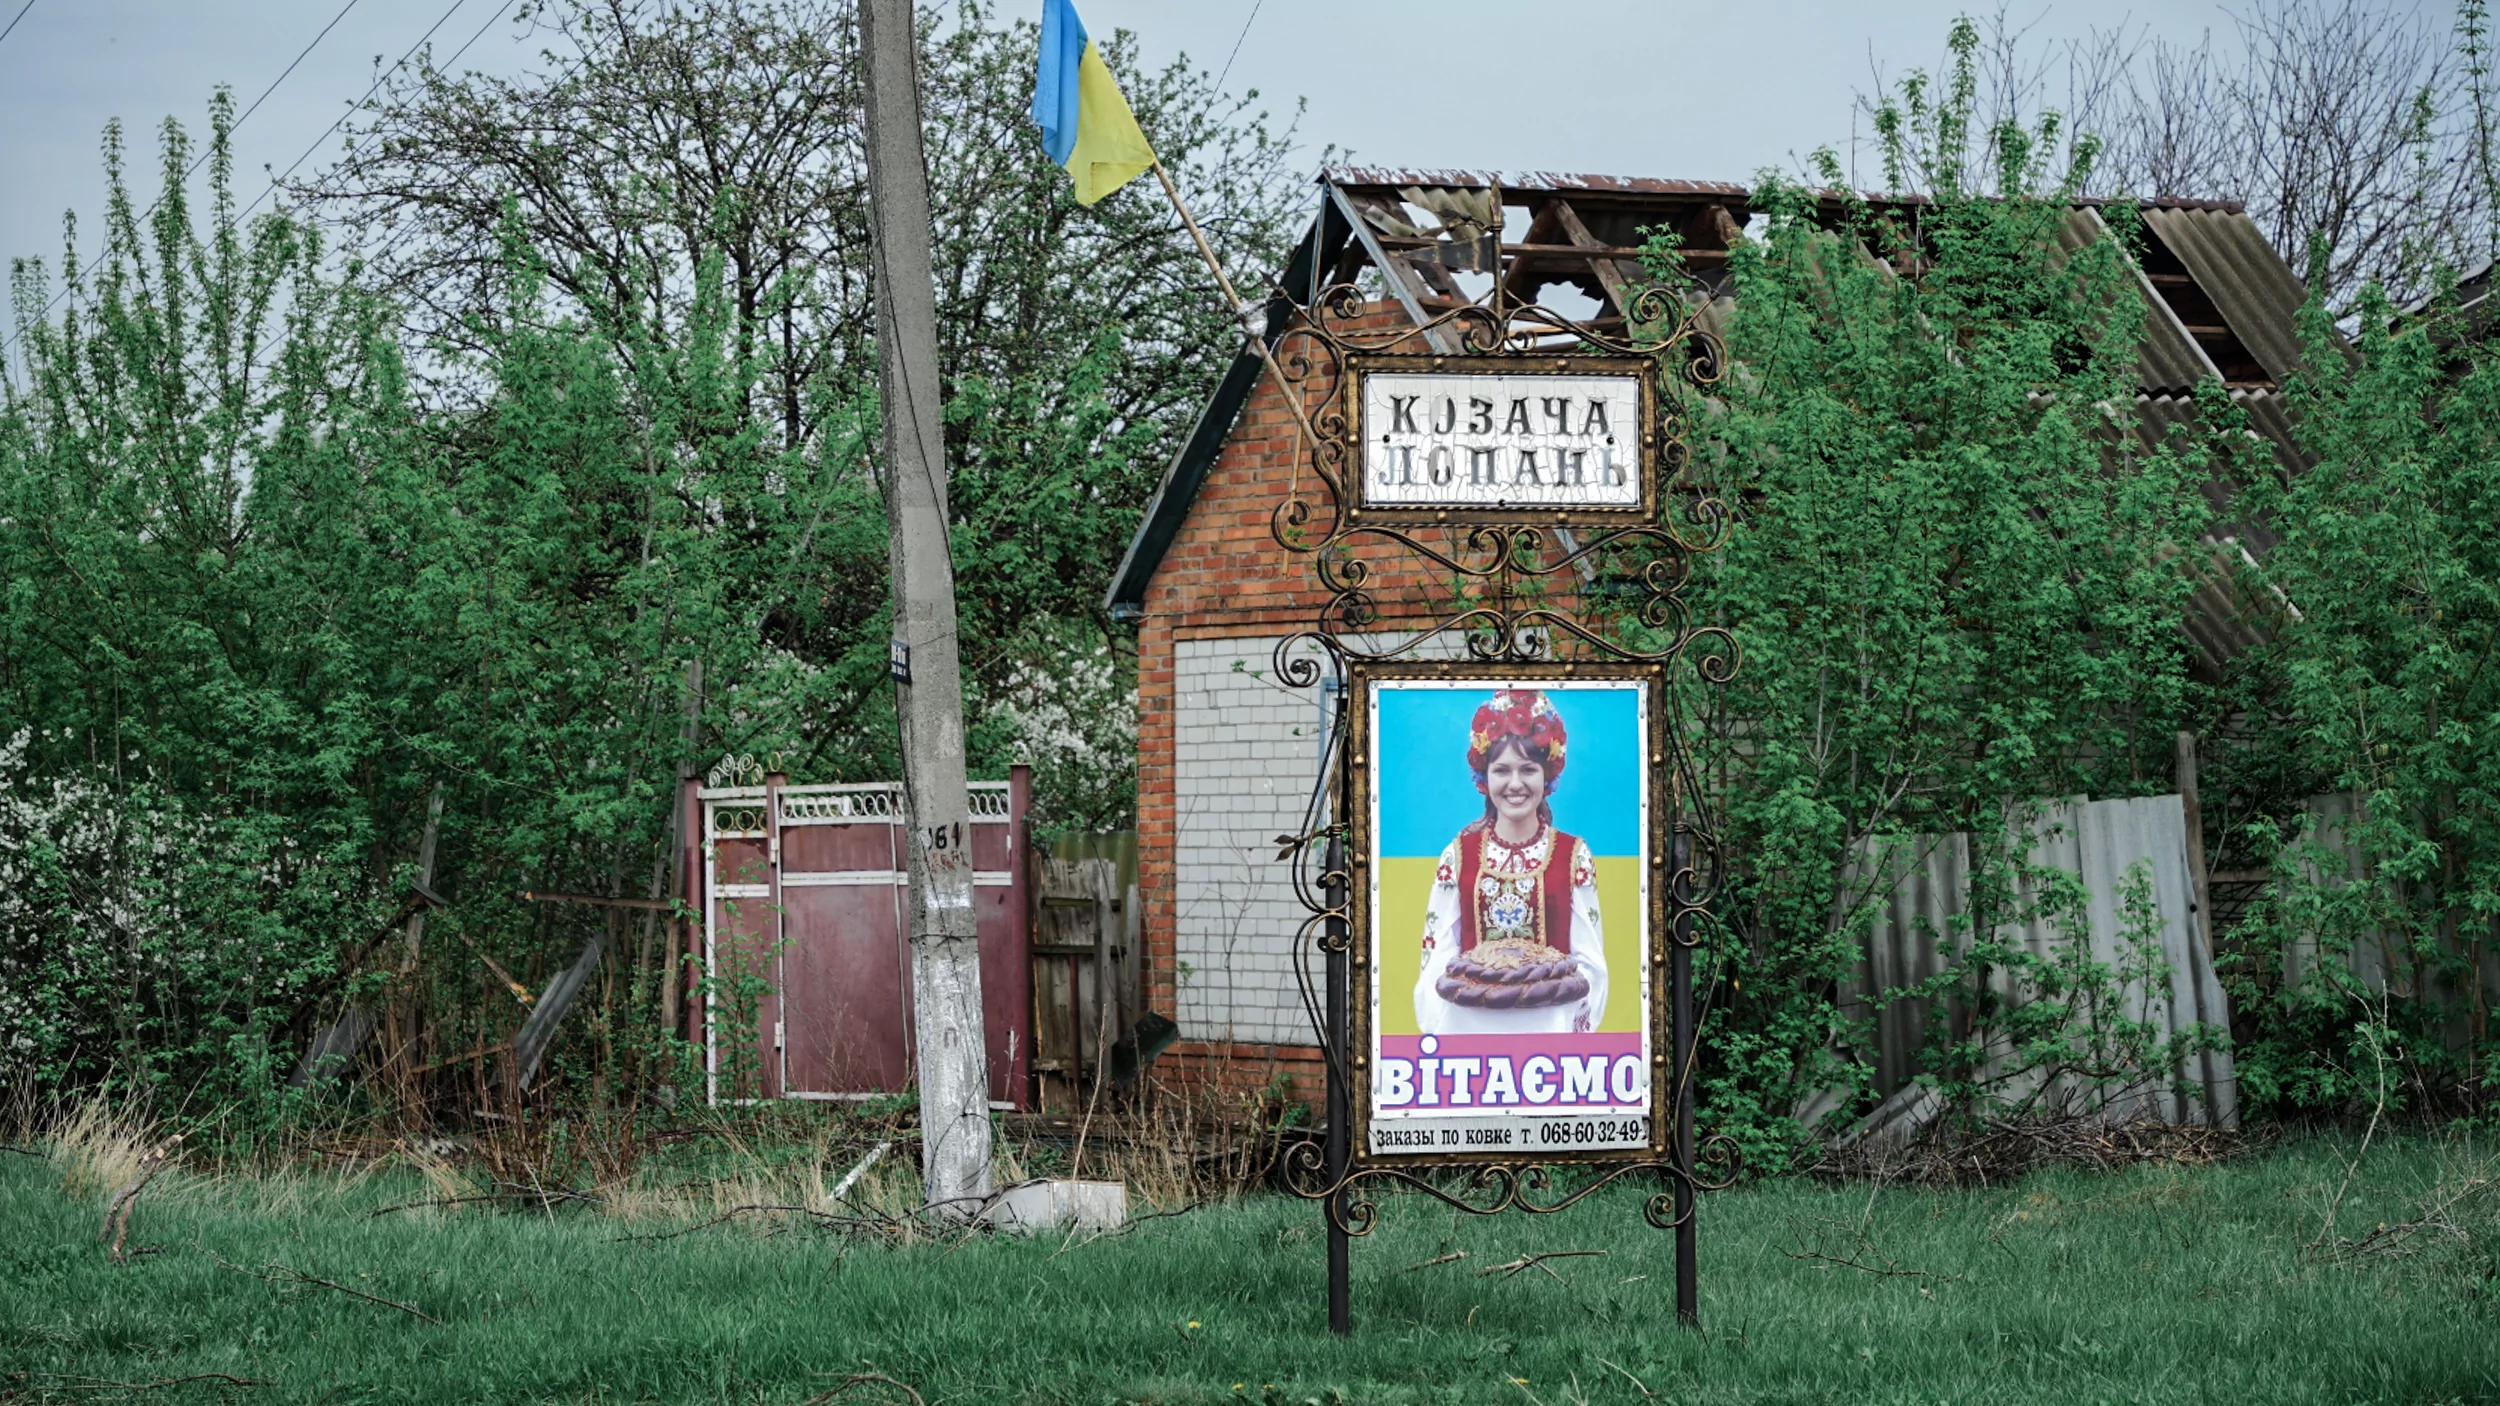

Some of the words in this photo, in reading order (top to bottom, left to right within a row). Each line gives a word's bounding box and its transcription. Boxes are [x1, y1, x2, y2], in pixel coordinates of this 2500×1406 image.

[1389, 394, 1609, 436] КОЗАЧА
[1378, 445, 1627, 487] ЛОПАНЬ
[1376, 1129, 1434, 1147] заказы
[1441, 1128, 1459, 1146] по
[1465, 1127, 1512, 1145] ковке
